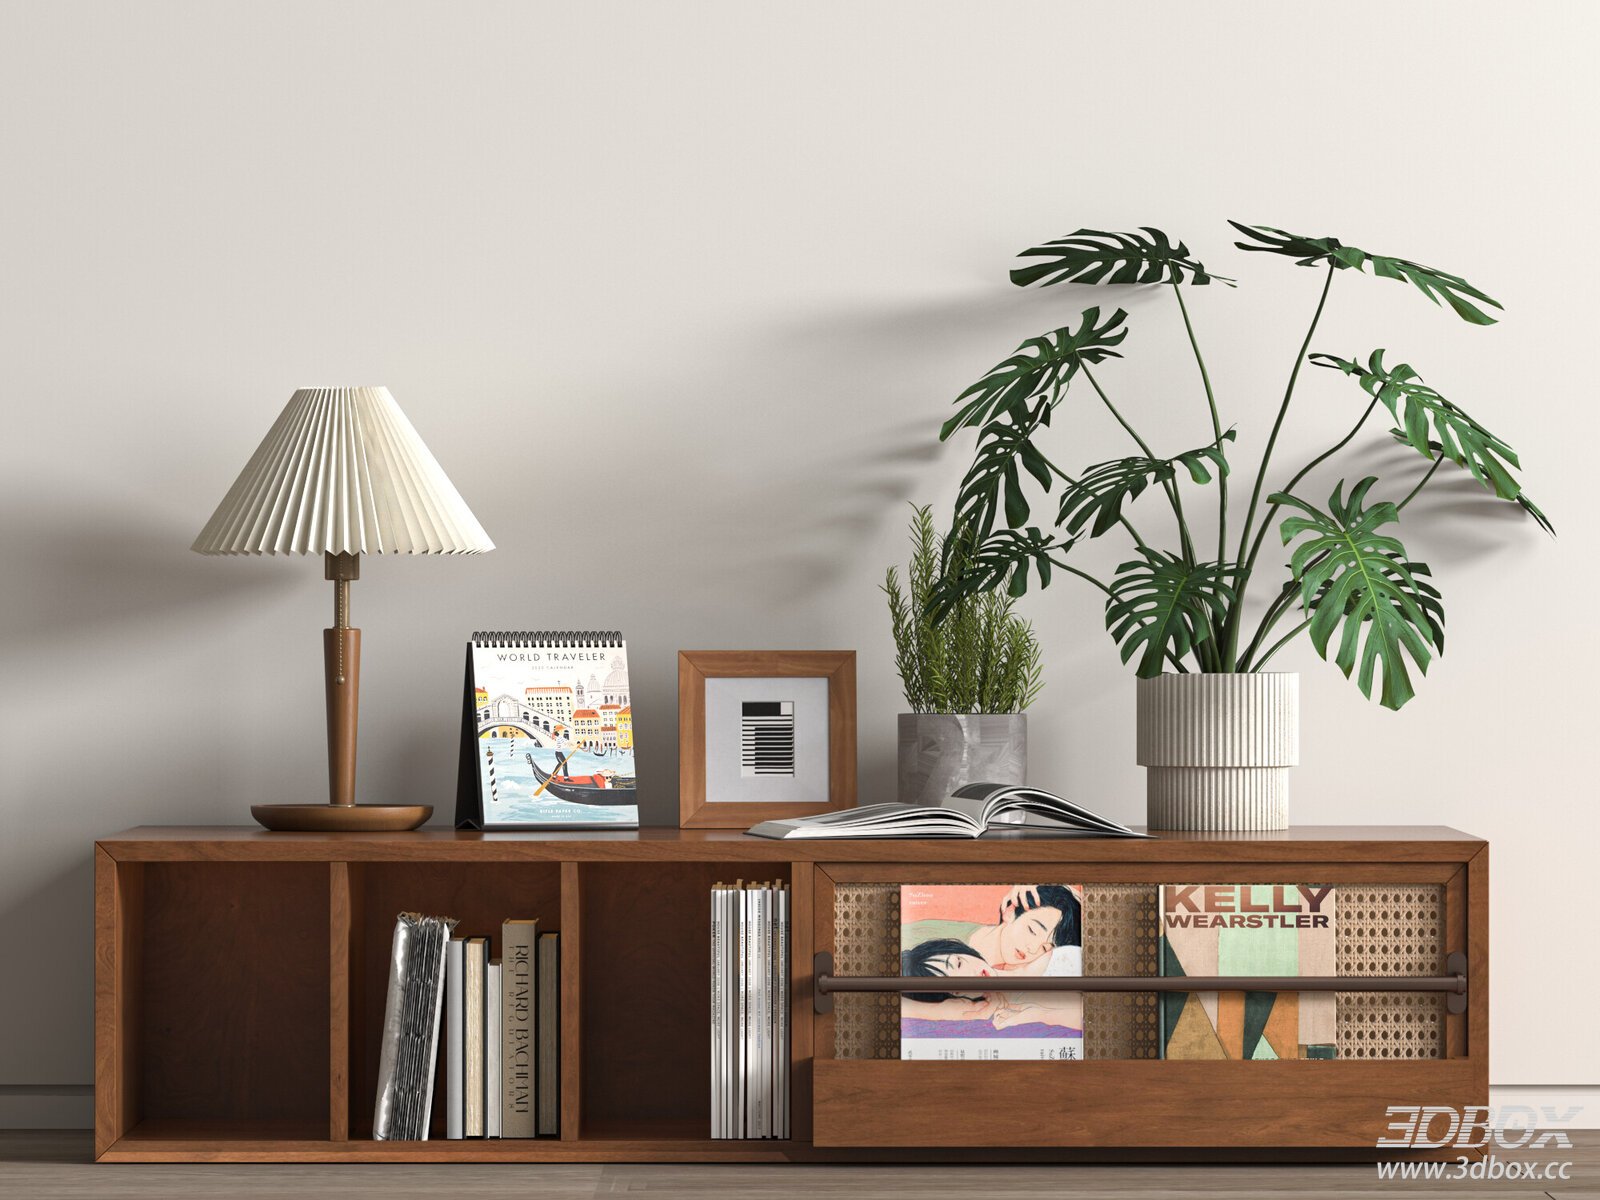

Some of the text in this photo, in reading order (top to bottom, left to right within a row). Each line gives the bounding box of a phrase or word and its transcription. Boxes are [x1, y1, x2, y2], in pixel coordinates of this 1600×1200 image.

[497, 652, 606, 662] WORLD TRAVELER
[1165, 885, 1334, 913] KELLY
[1165, 914, 1330, 929] WEARSTLER
[515, 945, 529, 1113] RICHARD BACHMAN
